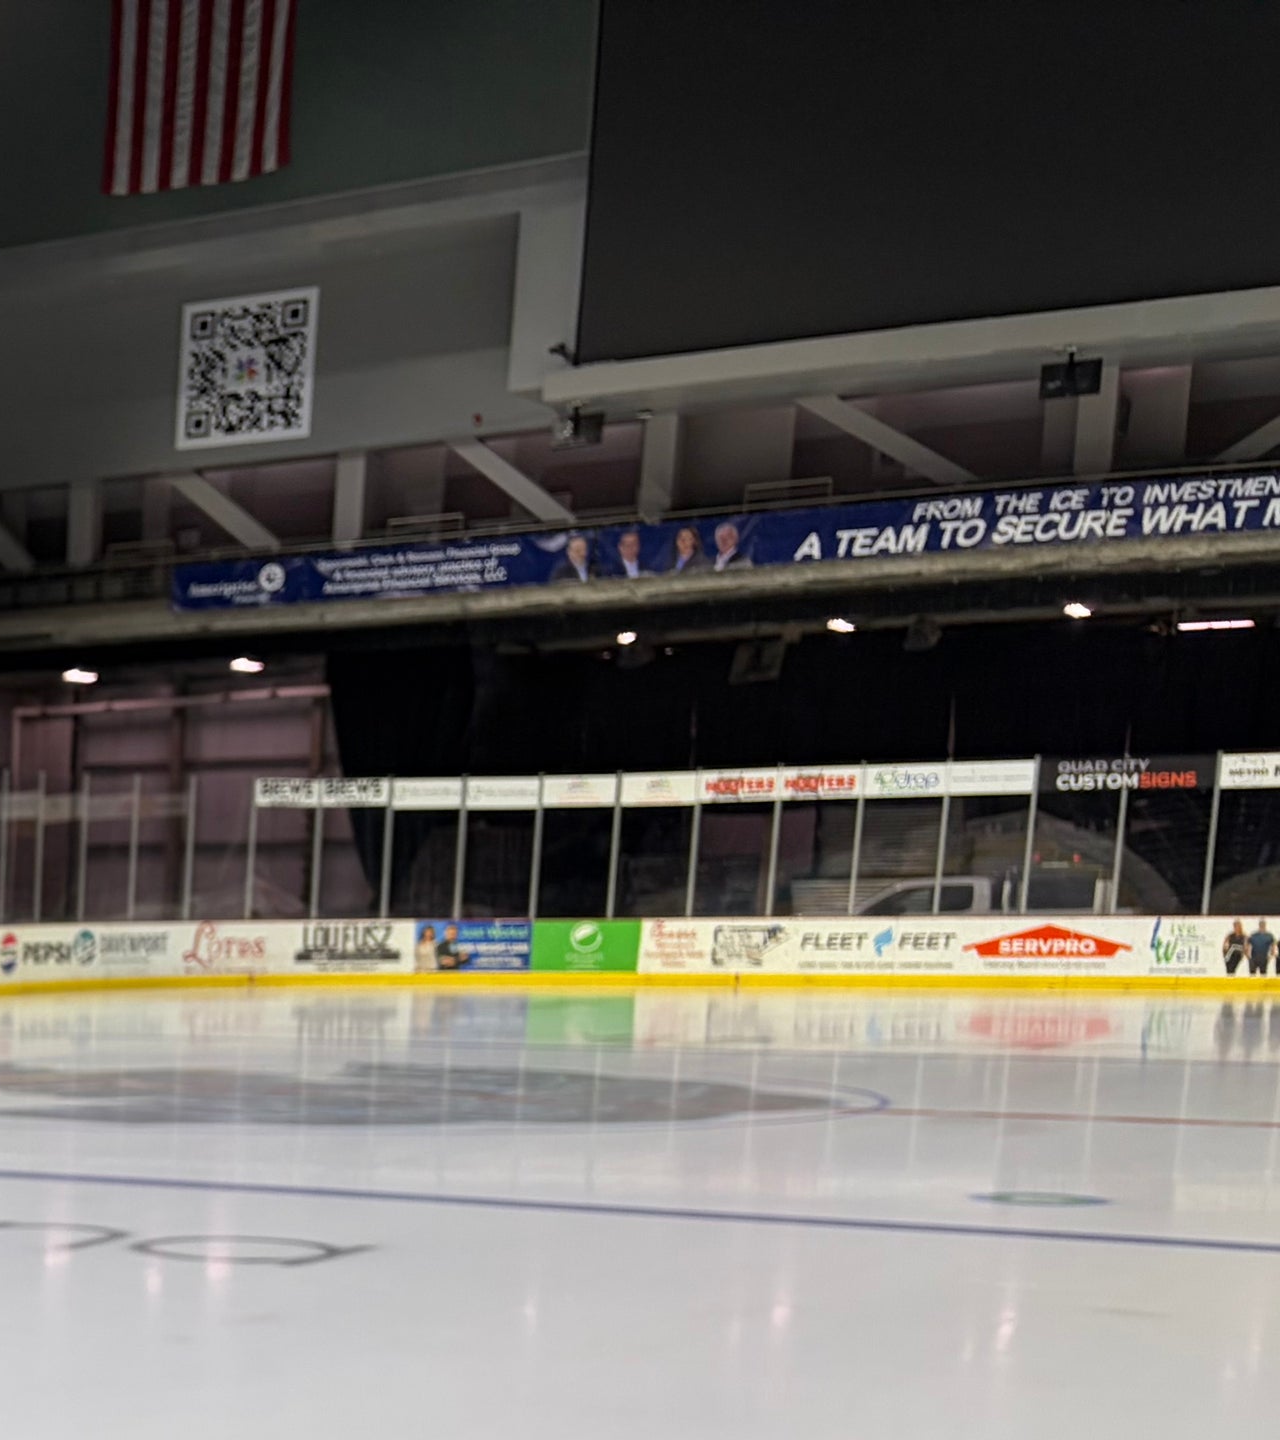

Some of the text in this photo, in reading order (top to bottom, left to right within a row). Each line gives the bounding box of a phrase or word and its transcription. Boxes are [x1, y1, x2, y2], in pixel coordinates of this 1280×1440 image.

[912, 497, 983, 523] FROM
[994, 492, 1043, 515] THE
[1049, 488, 1089, 511] ICE
[1101, 486, 1134, 507] TO
[794, 532, 821, 562] A
[836, 523, 930, 558] TEAM
[939, 518, 987, 549] TO
[991, 508, 1134, 545] SECURE
[1141, 499, 1260, 535] WHAT
[1058, 758, 1150, 773] QUAD CITY
[799, 932, 956, 951] FLEET FEET
[998, 938, 1096, 955] SERVPRO
[22, 942, 72, 965] PEPSI
